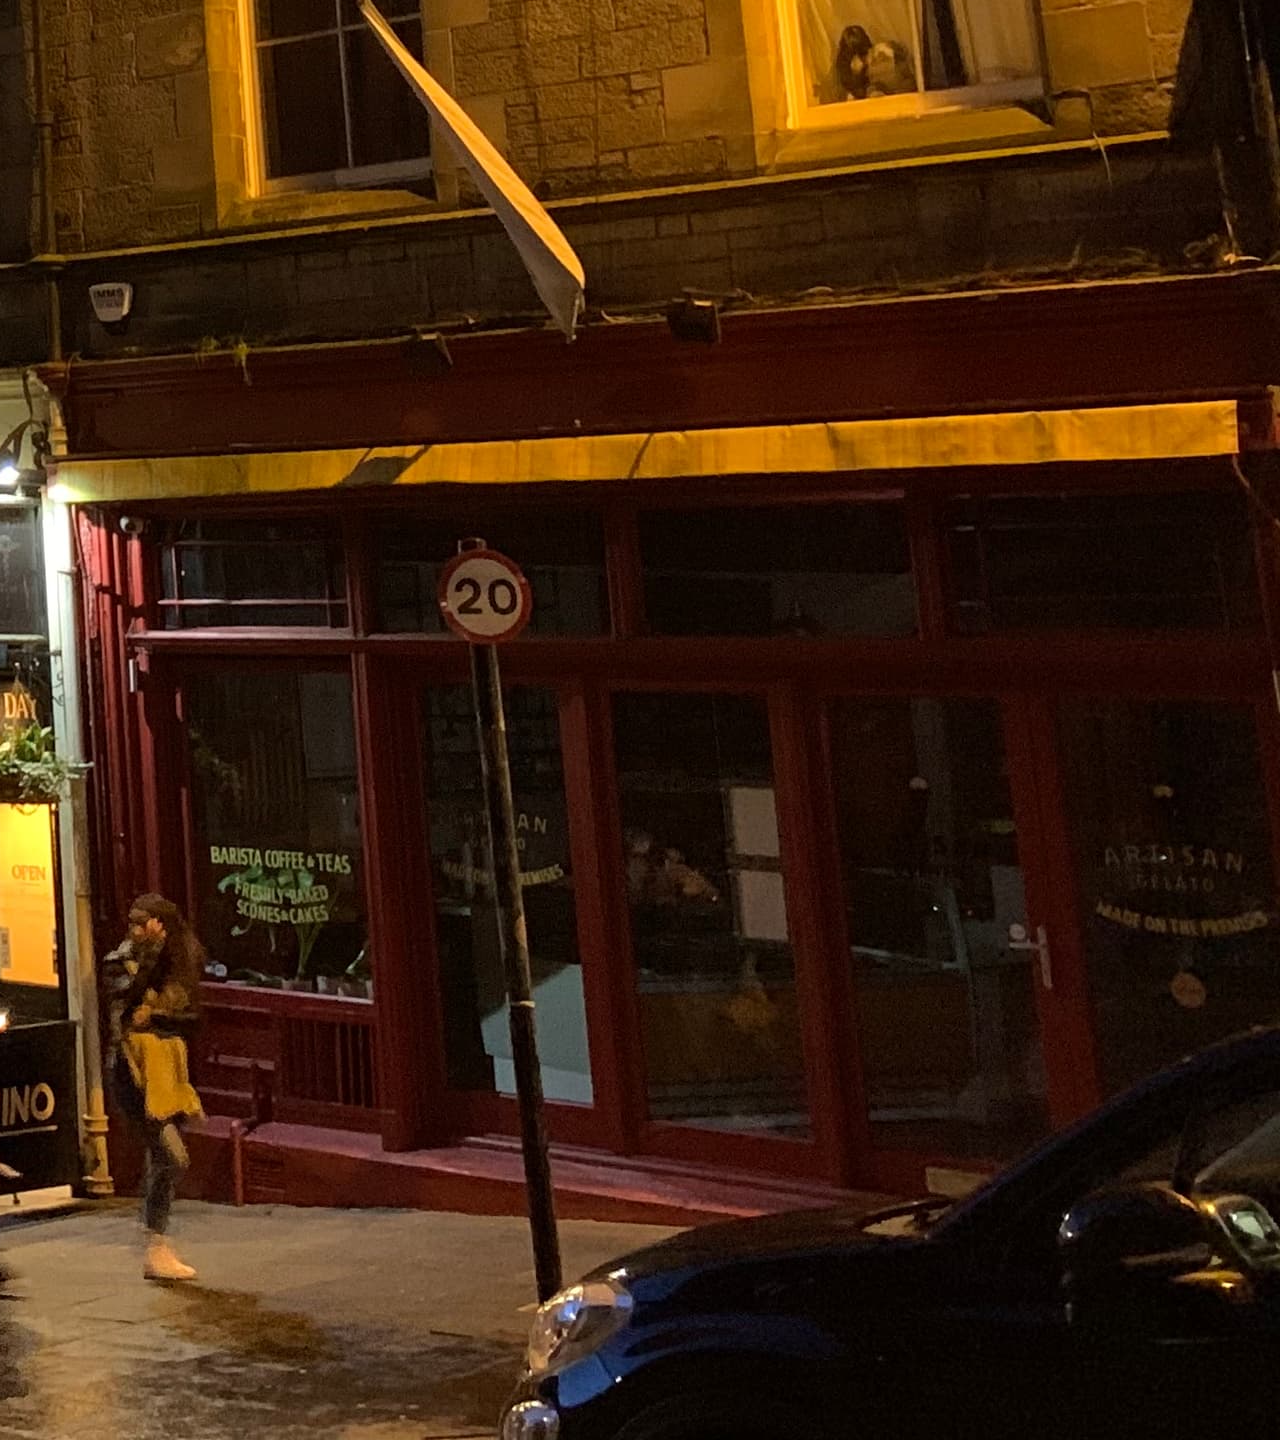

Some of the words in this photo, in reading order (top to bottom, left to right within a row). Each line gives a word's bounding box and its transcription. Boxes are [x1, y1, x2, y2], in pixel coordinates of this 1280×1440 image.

[454, 577, 518, 616] 20
[3, 692, 37, 720] DAY
[11, 864, 47, 881] OPEN
[210, 845, 263, 867] BARISTA
[264, 849, 305, 870] COFFEE
[306, 854, 316, 868] &
[315, 852, 352, 875] TEAS
[236, 898, 281, 924] SCONES
[289, 904, 330, 925] CAKES
